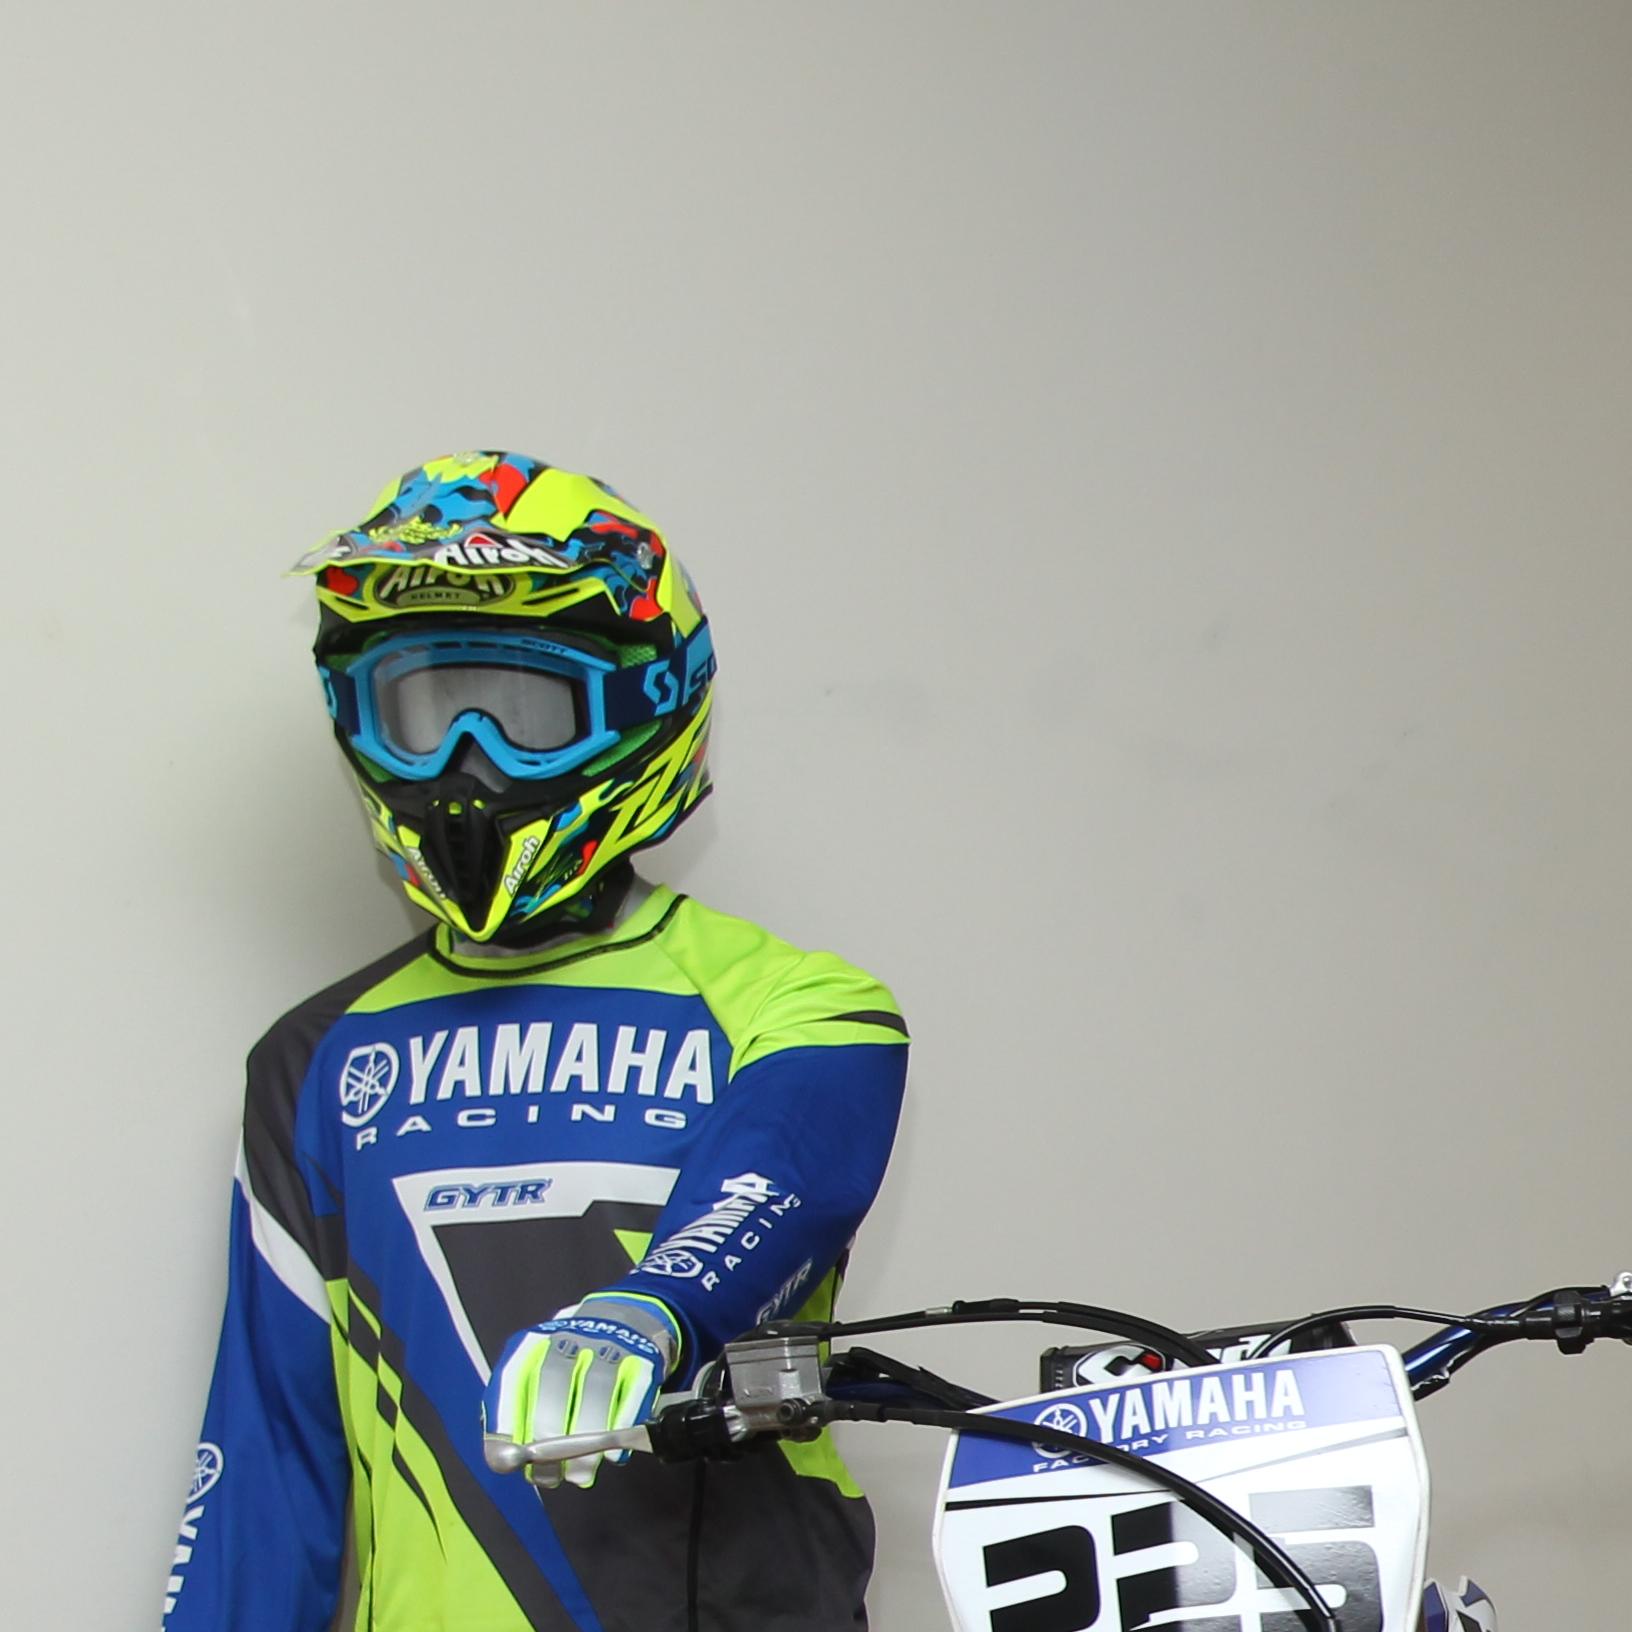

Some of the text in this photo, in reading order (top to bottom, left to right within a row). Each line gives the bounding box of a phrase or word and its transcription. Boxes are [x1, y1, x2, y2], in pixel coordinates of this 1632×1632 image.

[504, 835, 540, 897] Airoh
[408, 1022, 714, 1105] YAMAHA
[355, 1103, 687, 1151] RACING
[424, 1178, 554, 1212] GYTR
[1088, 1368, 1305, 1444] YAMAHA
[1185, 1419, 1308, 1441] RACING
